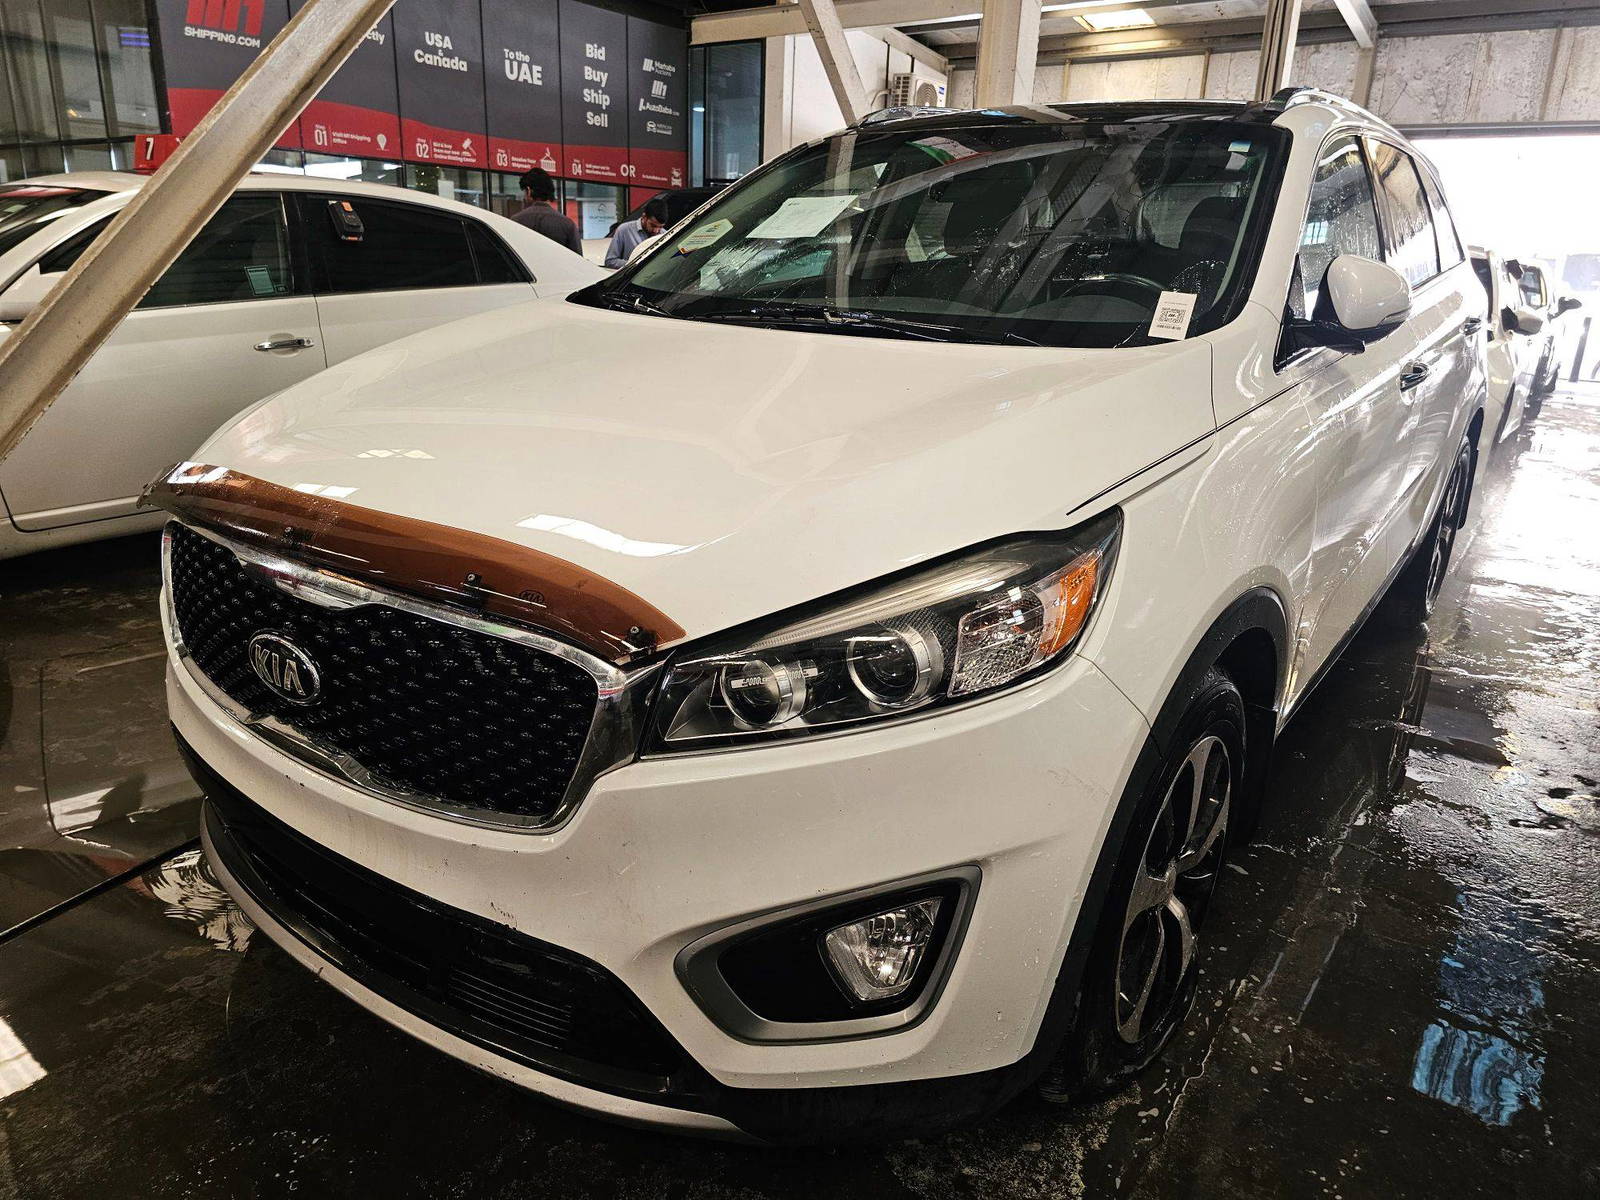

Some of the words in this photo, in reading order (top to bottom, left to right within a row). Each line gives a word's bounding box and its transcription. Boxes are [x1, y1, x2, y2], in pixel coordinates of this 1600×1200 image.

[184, 26, 261, 48] SHIPPING.COM
[366, 30, 386, 46] ctly
[424, 31, 453, 50] USA
[413, 49, 468, 72] Canada
[503, 48, 515, 60] To
[515, 50, 531, 63] the
[585, 43, 606, 61] Bid
[504, 59, 543, 86] UAE
[584, 65, 609, 88] Buy
[582, 88, 611, 110] Ship
[586, 111, 608, 128] Sell
[314, 129, 328, 146] 01
[145, 137, 154, 160] 7
[415, 142, 429, 159] 02
[496, 152, 508, 167] 03
[572, 162, 583, 176] 04
[620, 164, 636, 178] OR
[254, 643, 307, 696] KIA
